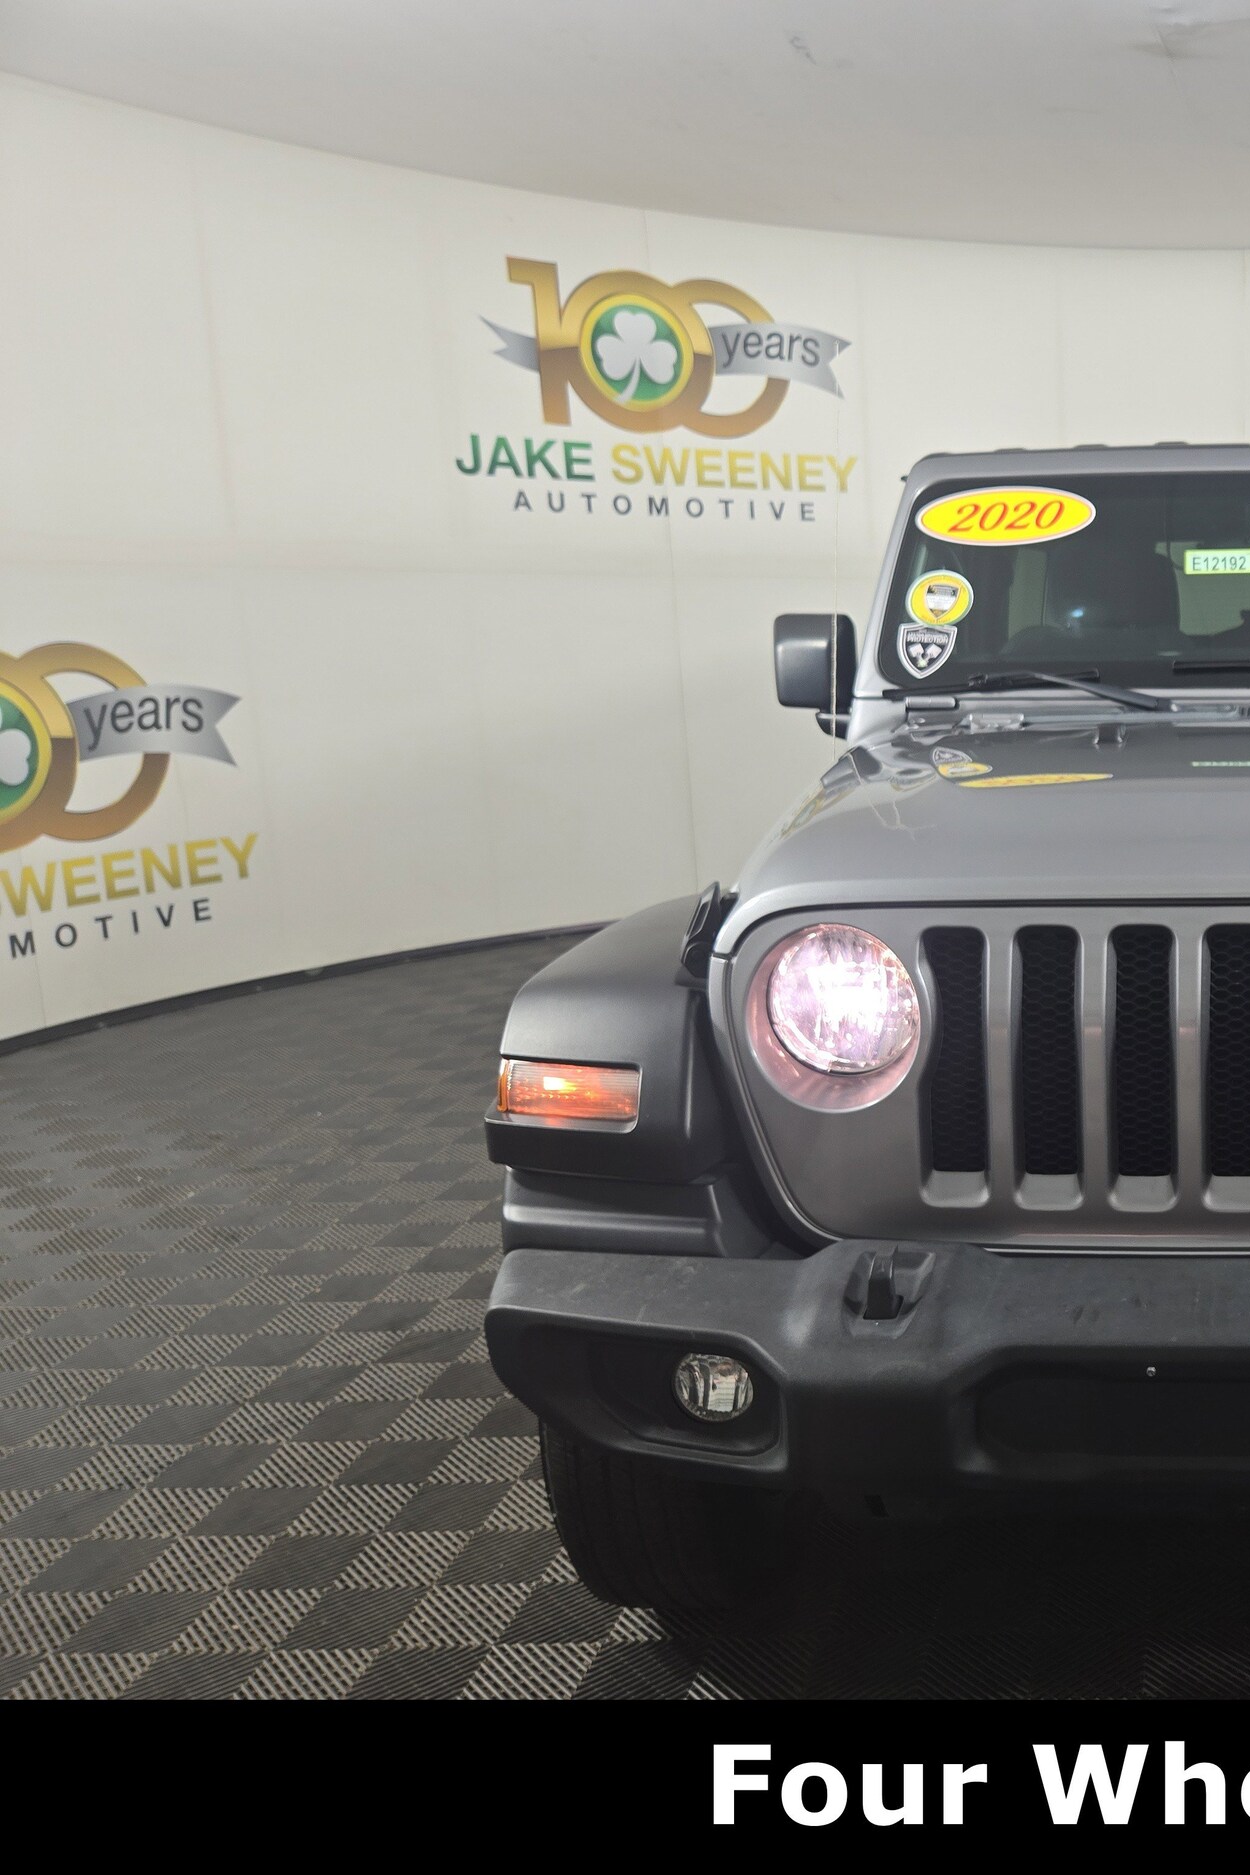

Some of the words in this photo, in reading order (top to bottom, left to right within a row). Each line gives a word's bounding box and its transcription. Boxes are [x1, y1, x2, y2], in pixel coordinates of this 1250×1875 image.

[722, 329, 821, 369] years
[455, 433, 594, 482] JAKE
[612, 443, 857, 492] SWEENEY
[513, 491, 816, 521] AUTOMOTIVE
[948, 500, 1065, 532] 2020
[1192, 556, 1247, 571] E12192
[84, 695, 204, 752] years
[0, 832, 258, 918] WEENEY
